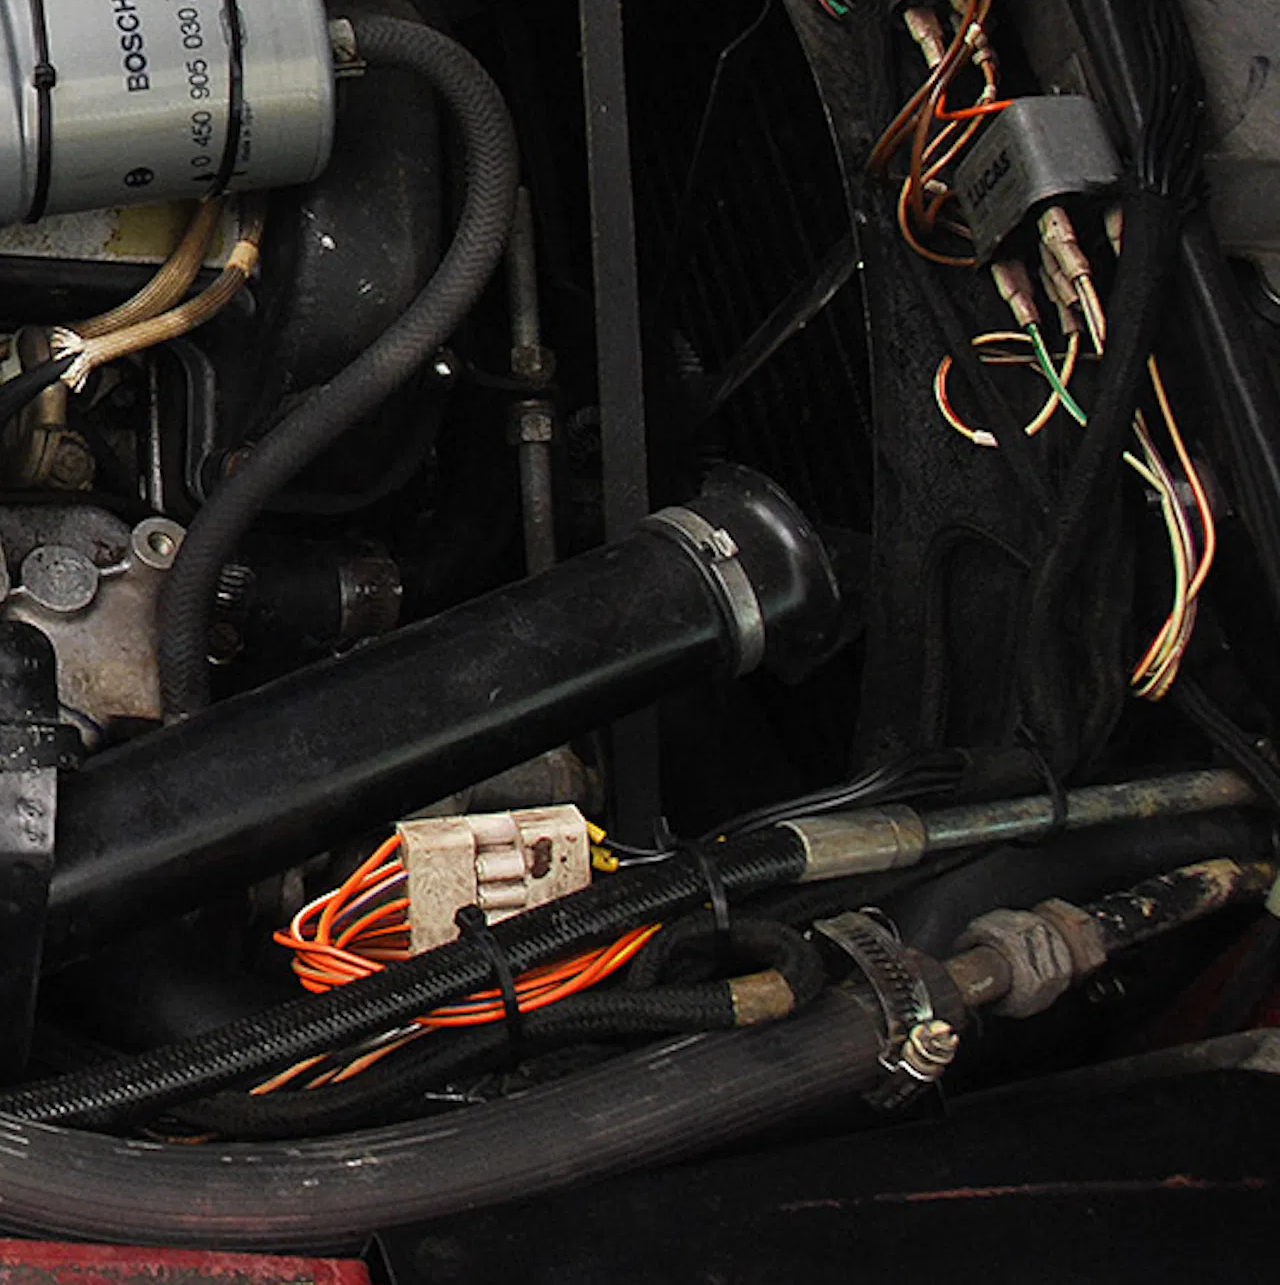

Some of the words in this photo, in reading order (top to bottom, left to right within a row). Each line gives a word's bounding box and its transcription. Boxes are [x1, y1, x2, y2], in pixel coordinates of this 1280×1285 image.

[177, 7, 204, 50] 030
[185, 58, 211, 100] 905
[191, 110, 213, 148] 450
